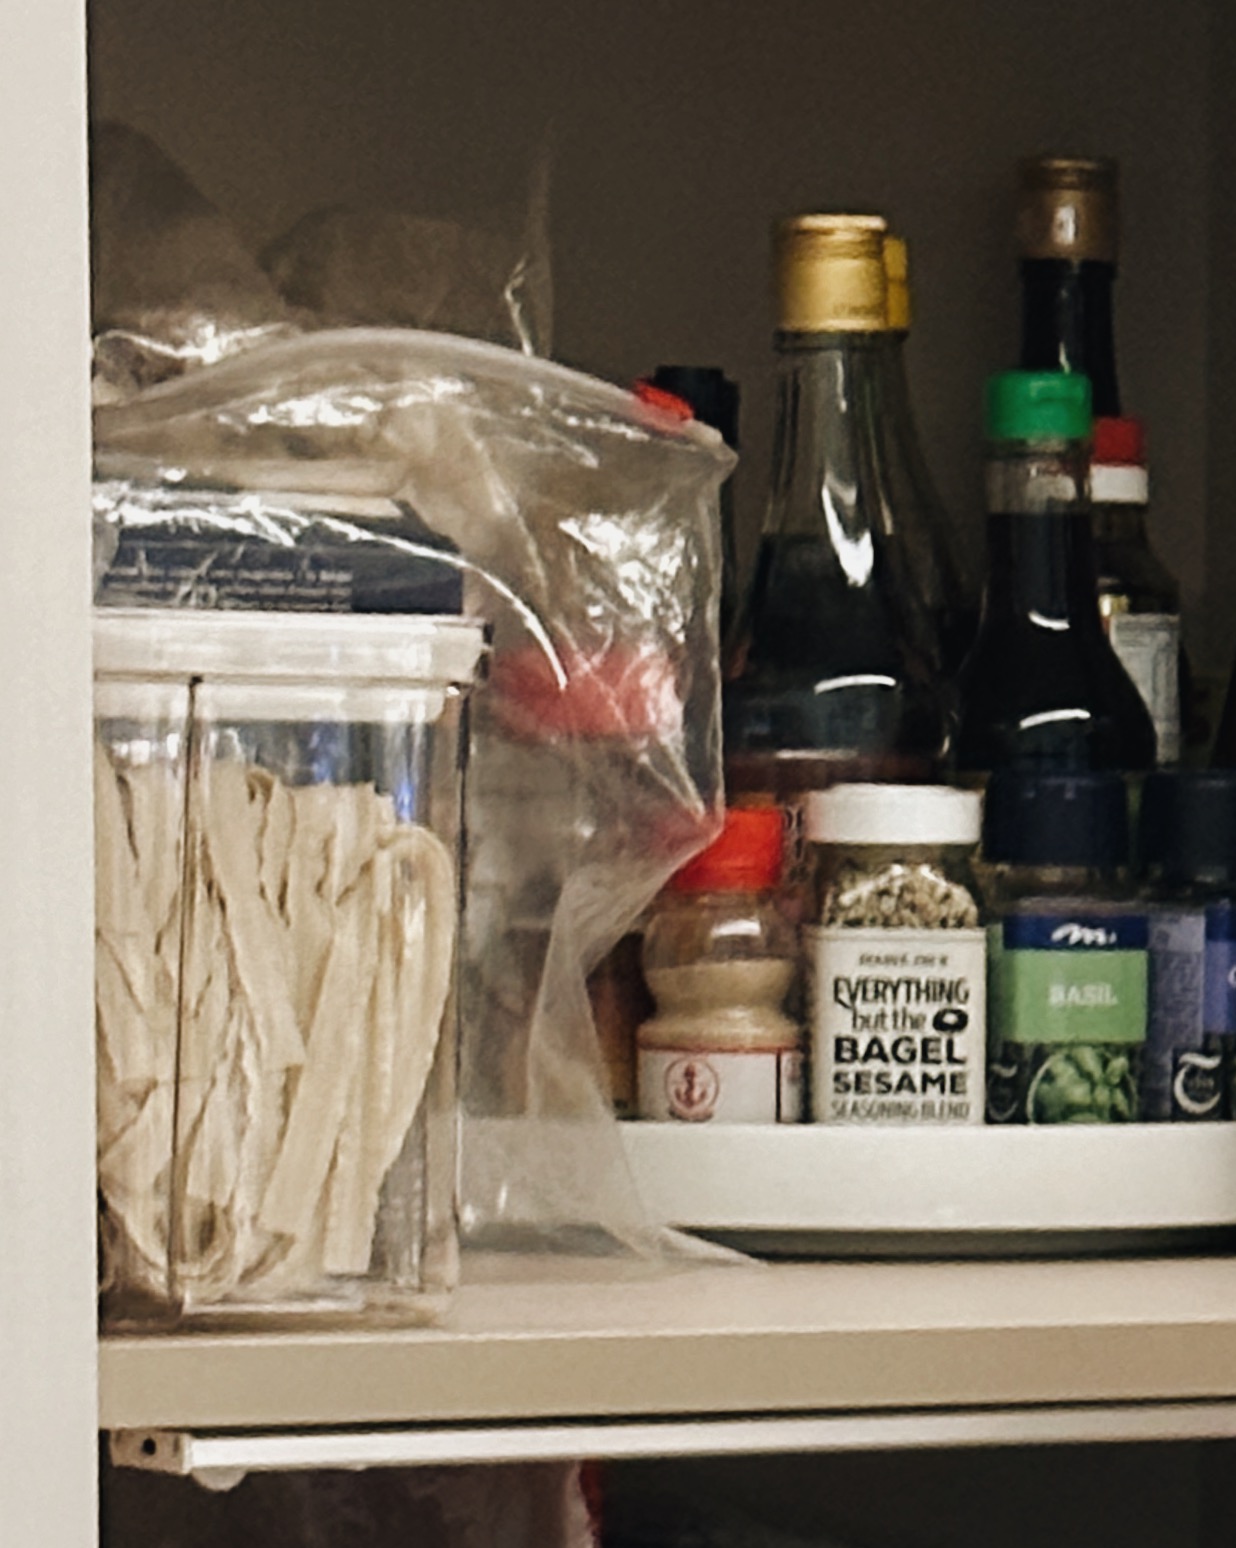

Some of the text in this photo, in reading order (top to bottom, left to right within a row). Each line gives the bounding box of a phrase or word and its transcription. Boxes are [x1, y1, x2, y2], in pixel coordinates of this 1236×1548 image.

[834, 976, 969, 1006] EVERYTHING
[1050, 982, 1118, 1006] BASIL
[852, 1007, 926, 1031] but the
[834, 1036, 967, 1064] BAGEL
[833, 1071, 968, 1095] SESAME
